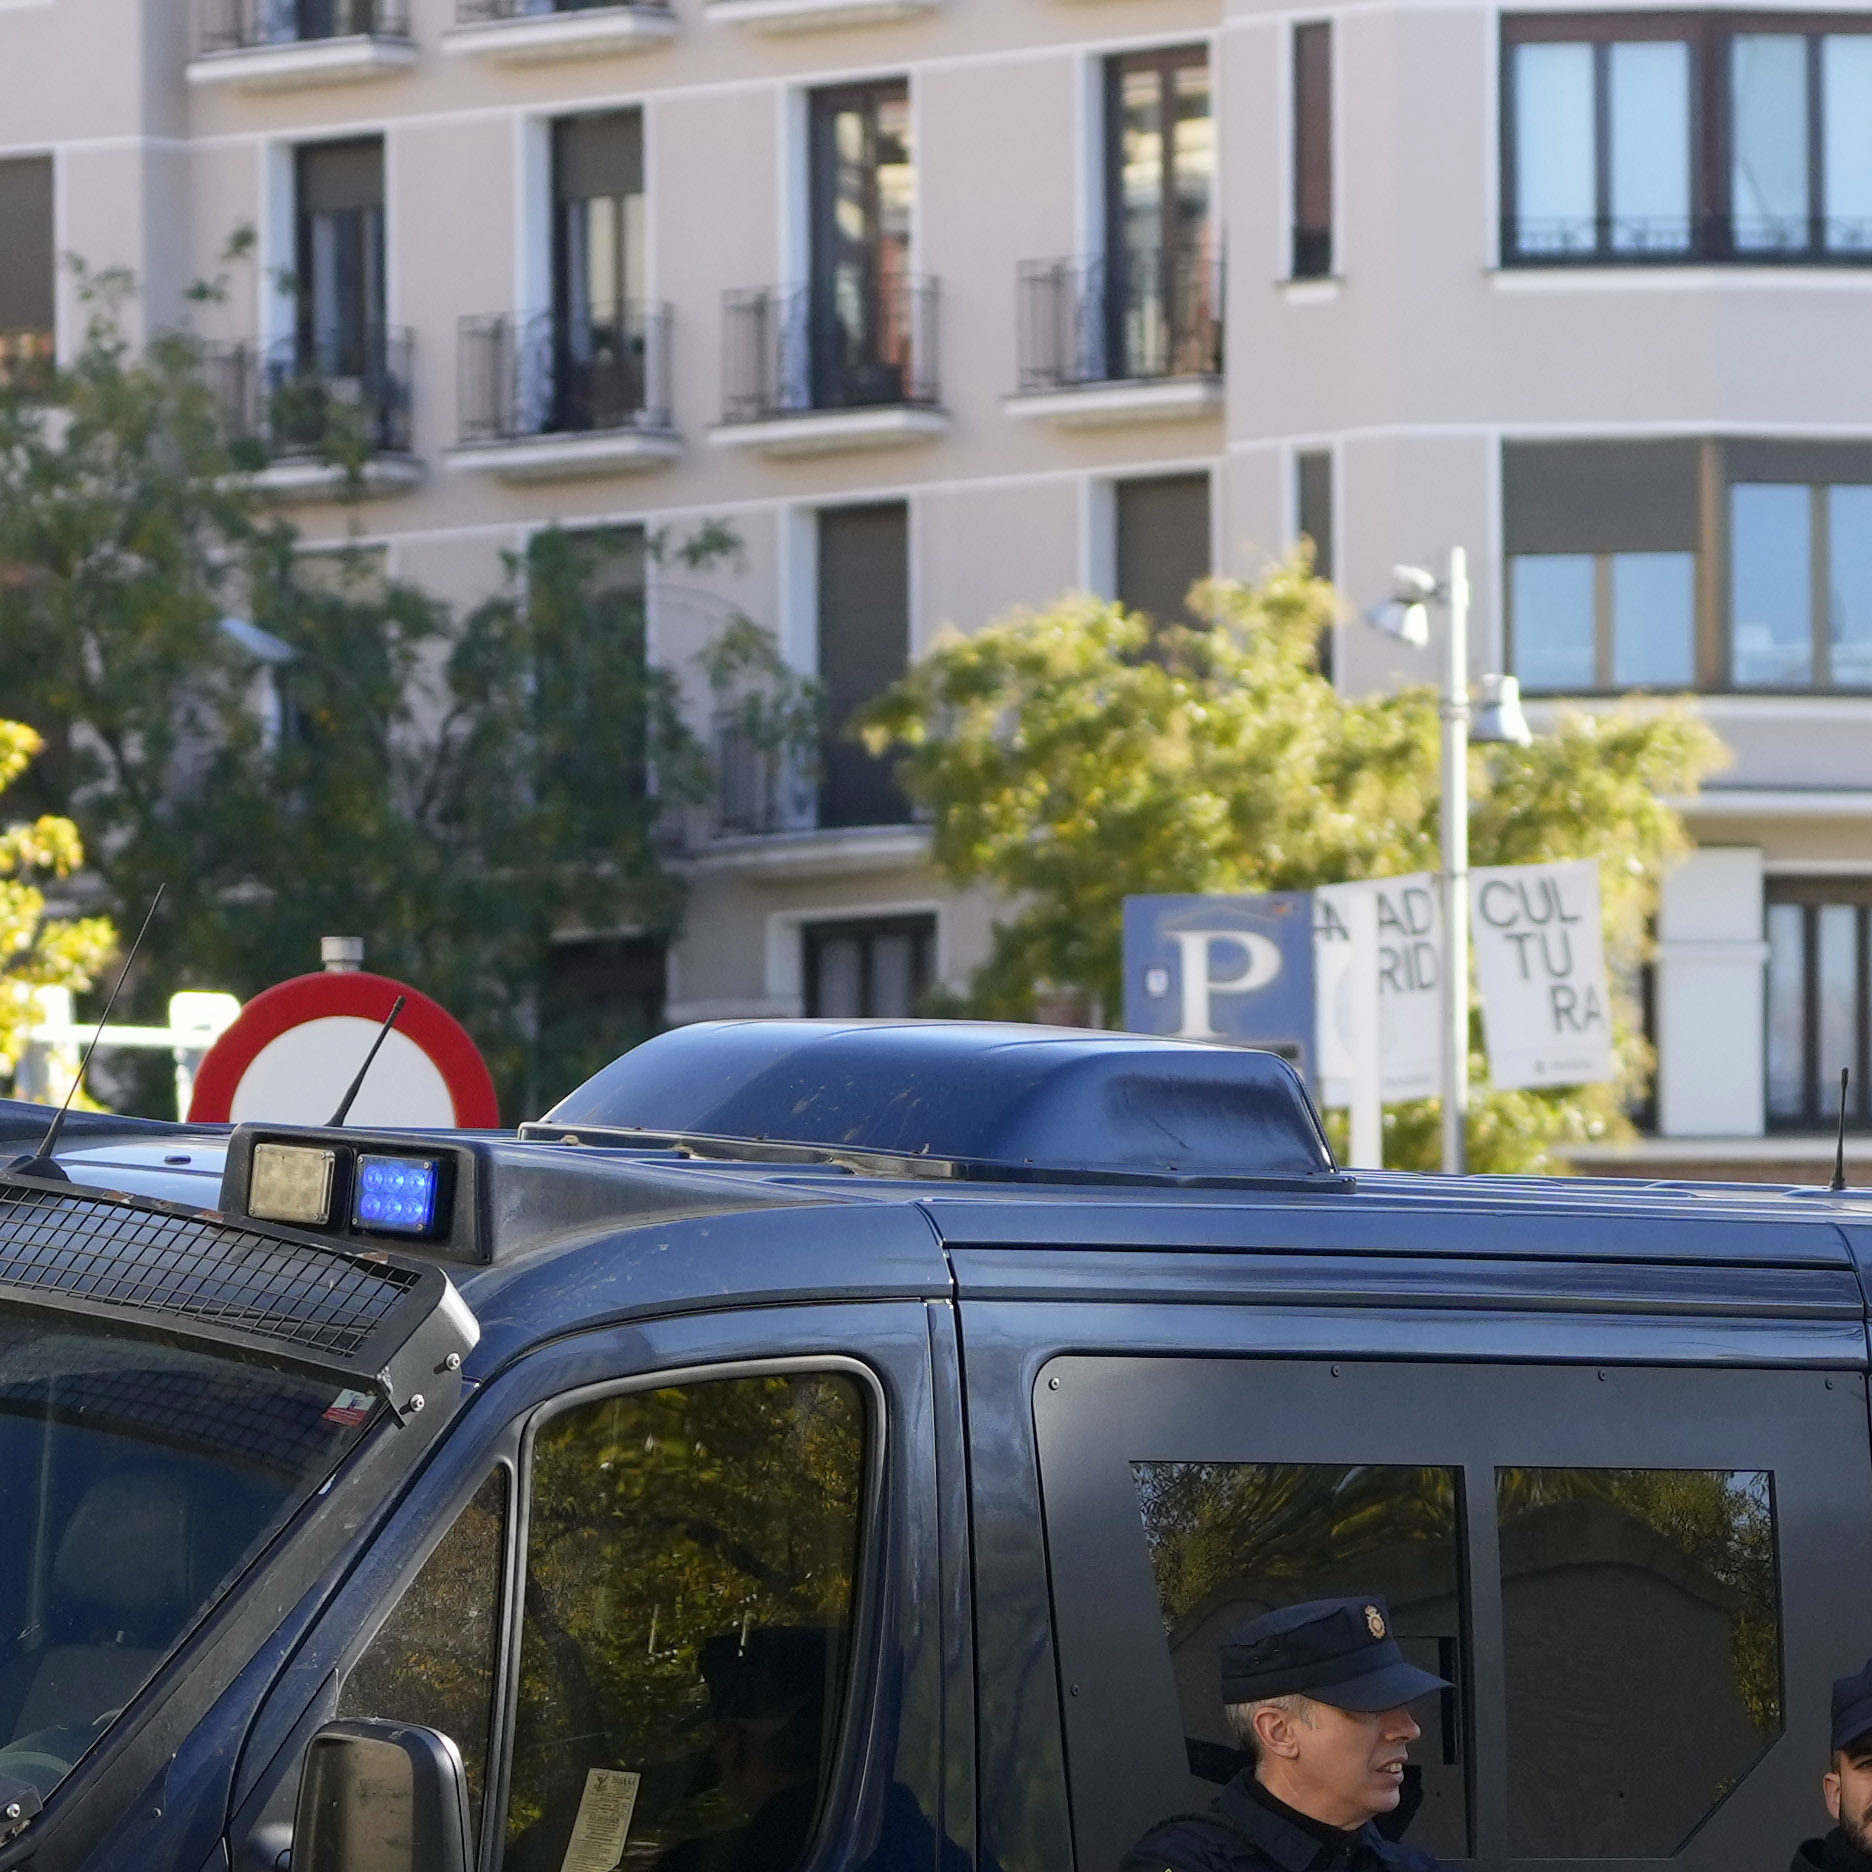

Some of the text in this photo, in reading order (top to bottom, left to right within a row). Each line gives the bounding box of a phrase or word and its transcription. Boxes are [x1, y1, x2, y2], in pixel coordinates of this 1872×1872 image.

[1479, 878, 1579, 927] CUL
[1506, 930, 1572, 980] TU
[1165, 930, 1282, 1039] P
